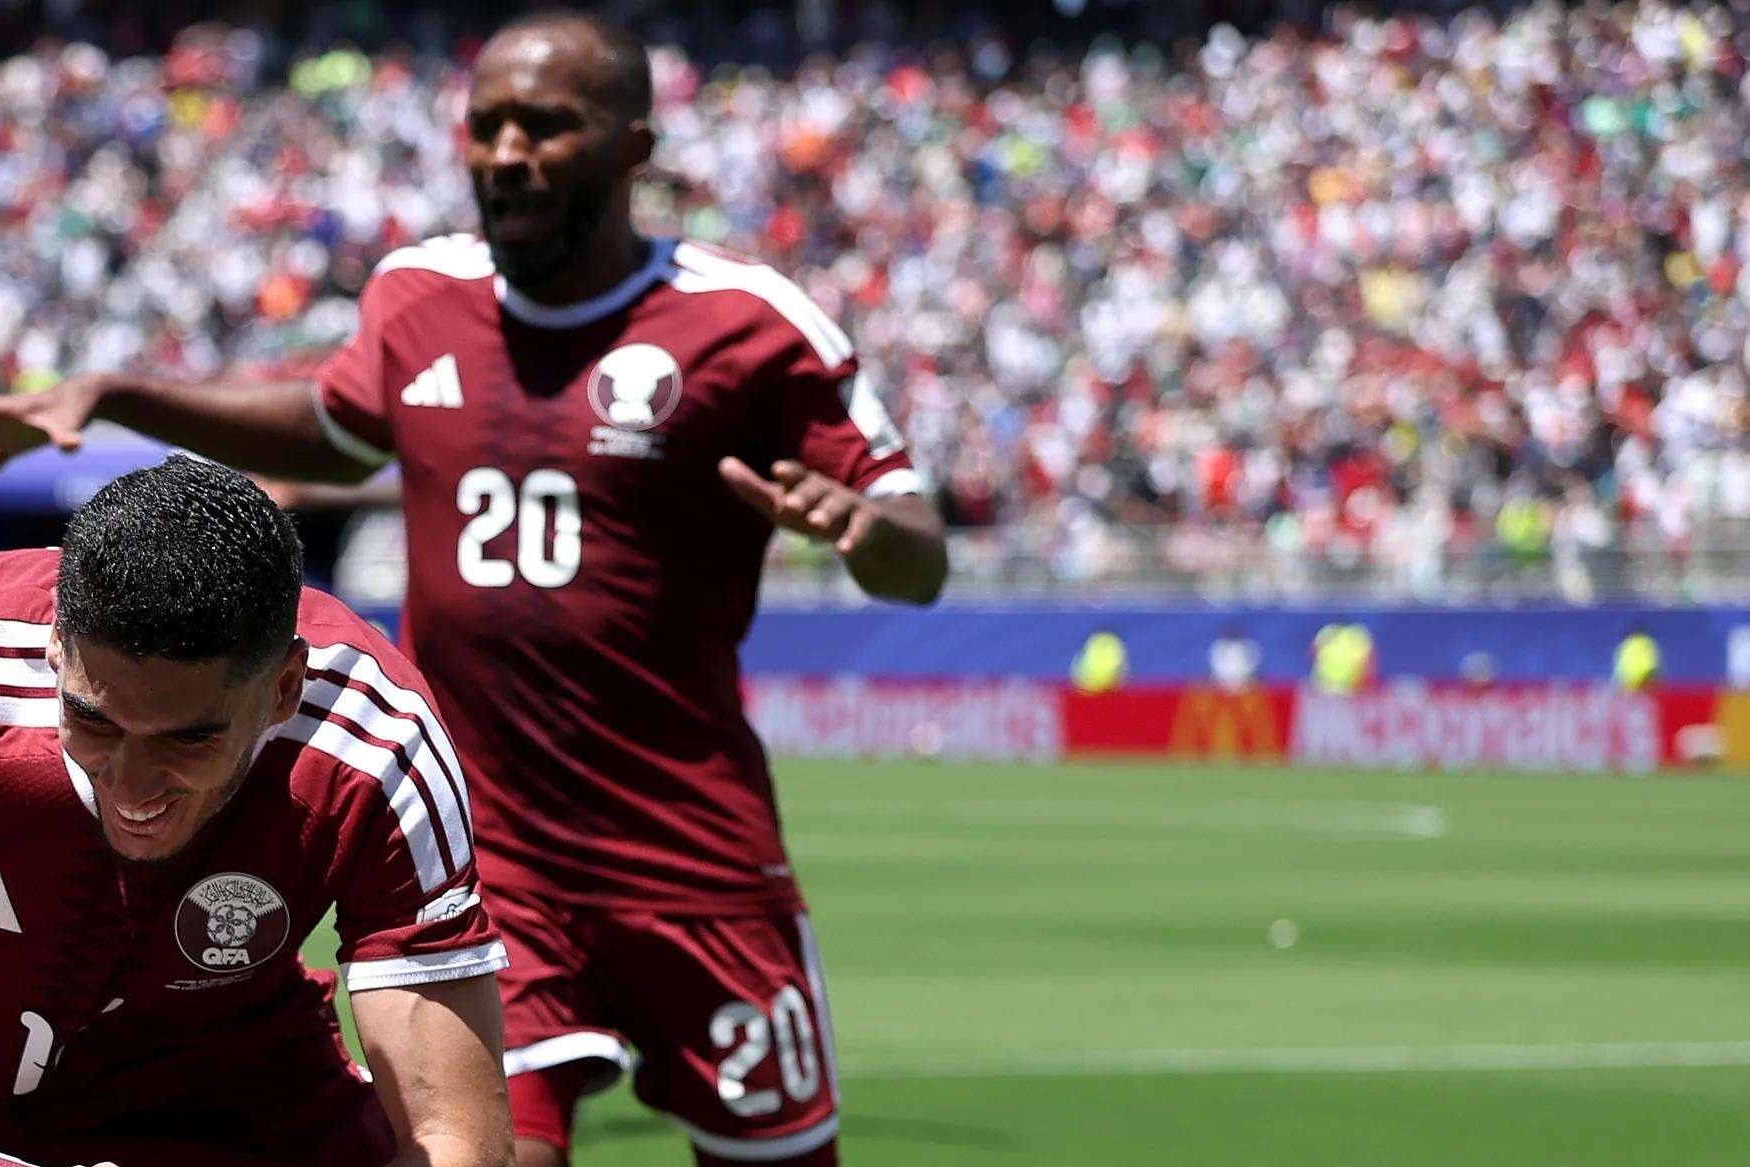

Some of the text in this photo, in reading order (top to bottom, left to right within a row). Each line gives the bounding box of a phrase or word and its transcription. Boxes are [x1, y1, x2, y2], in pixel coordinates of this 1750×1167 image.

[456, 466, 582, 588] 20
[202, 947, 251, 965] QFA
[709, 984, 820, 1117] 20
